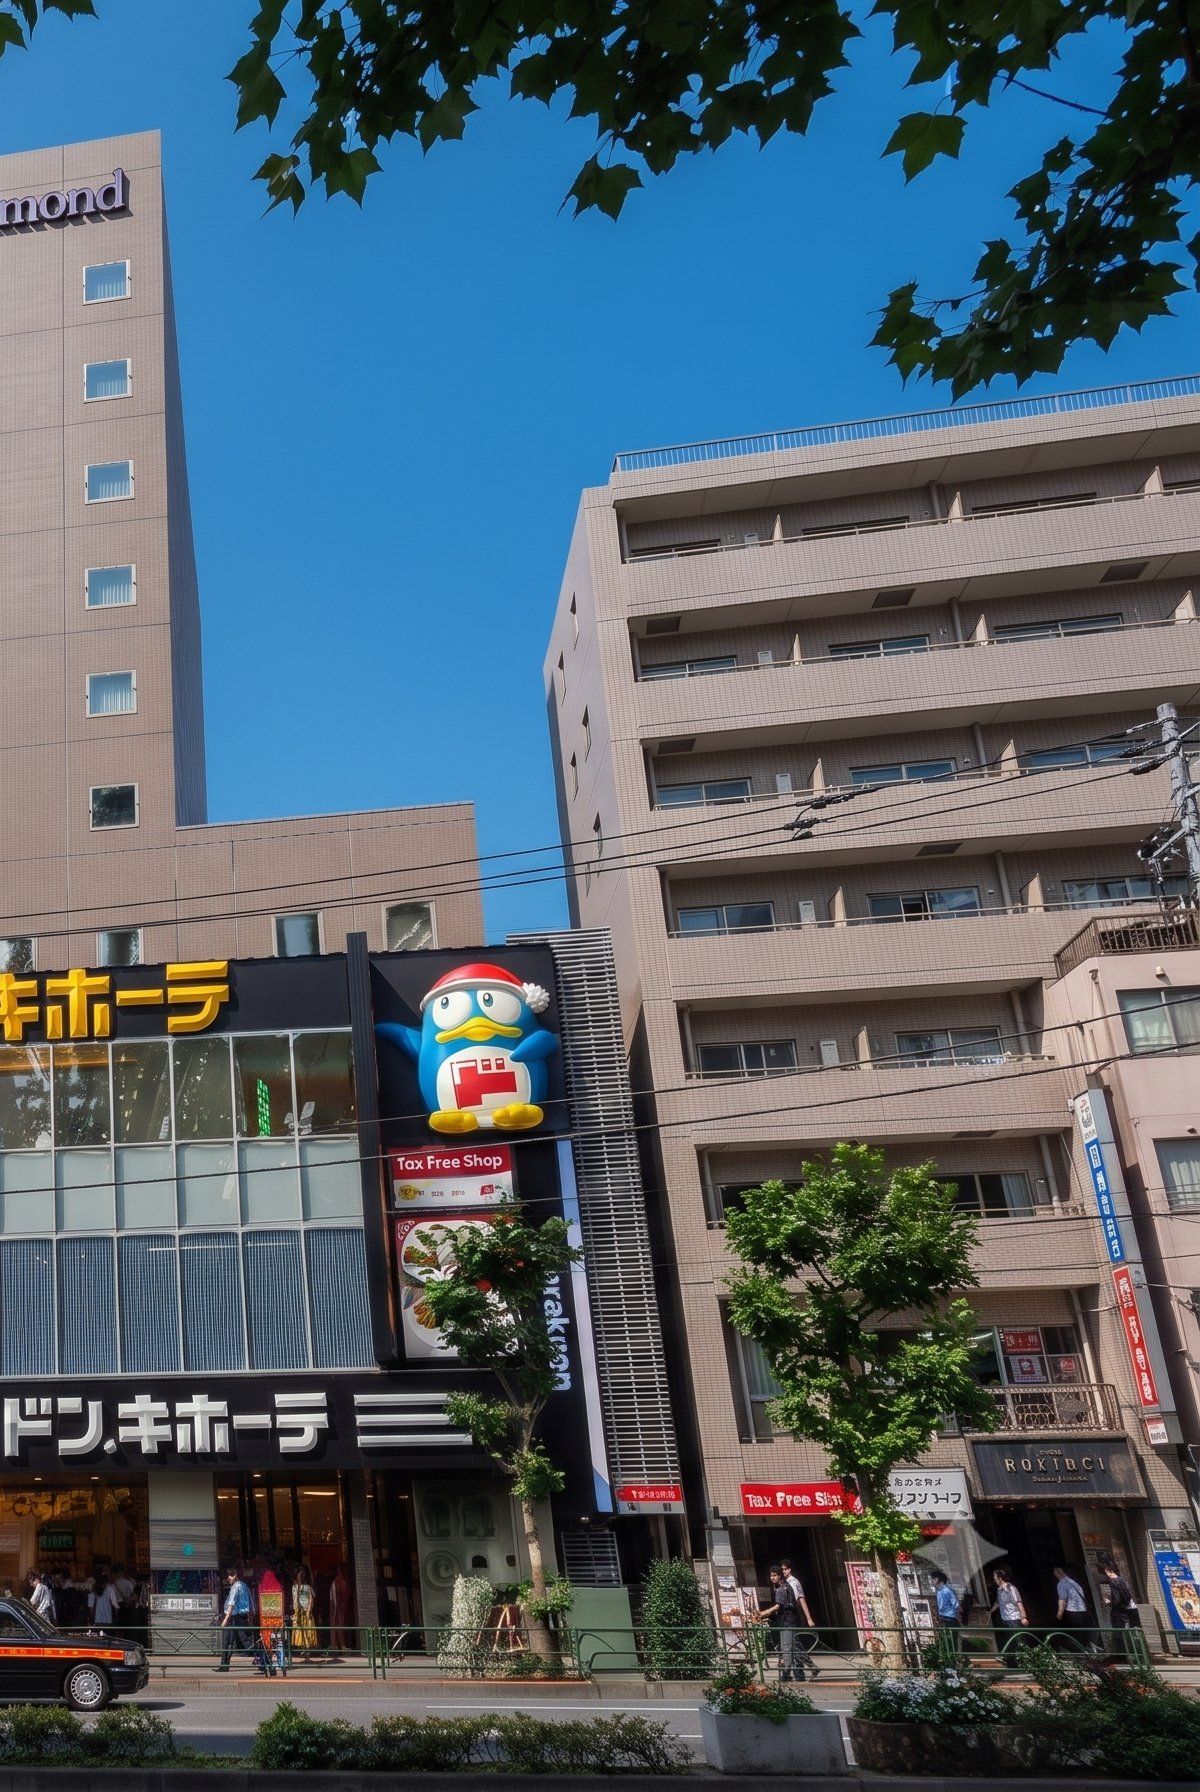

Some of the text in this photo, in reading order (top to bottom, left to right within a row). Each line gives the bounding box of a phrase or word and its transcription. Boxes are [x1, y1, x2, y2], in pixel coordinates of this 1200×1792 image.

[397, 1154, 503, 1171] Tax Free Shop
[745, 1493, 774, 1508] Tax
[775, 1491, 812, 1508] Free
